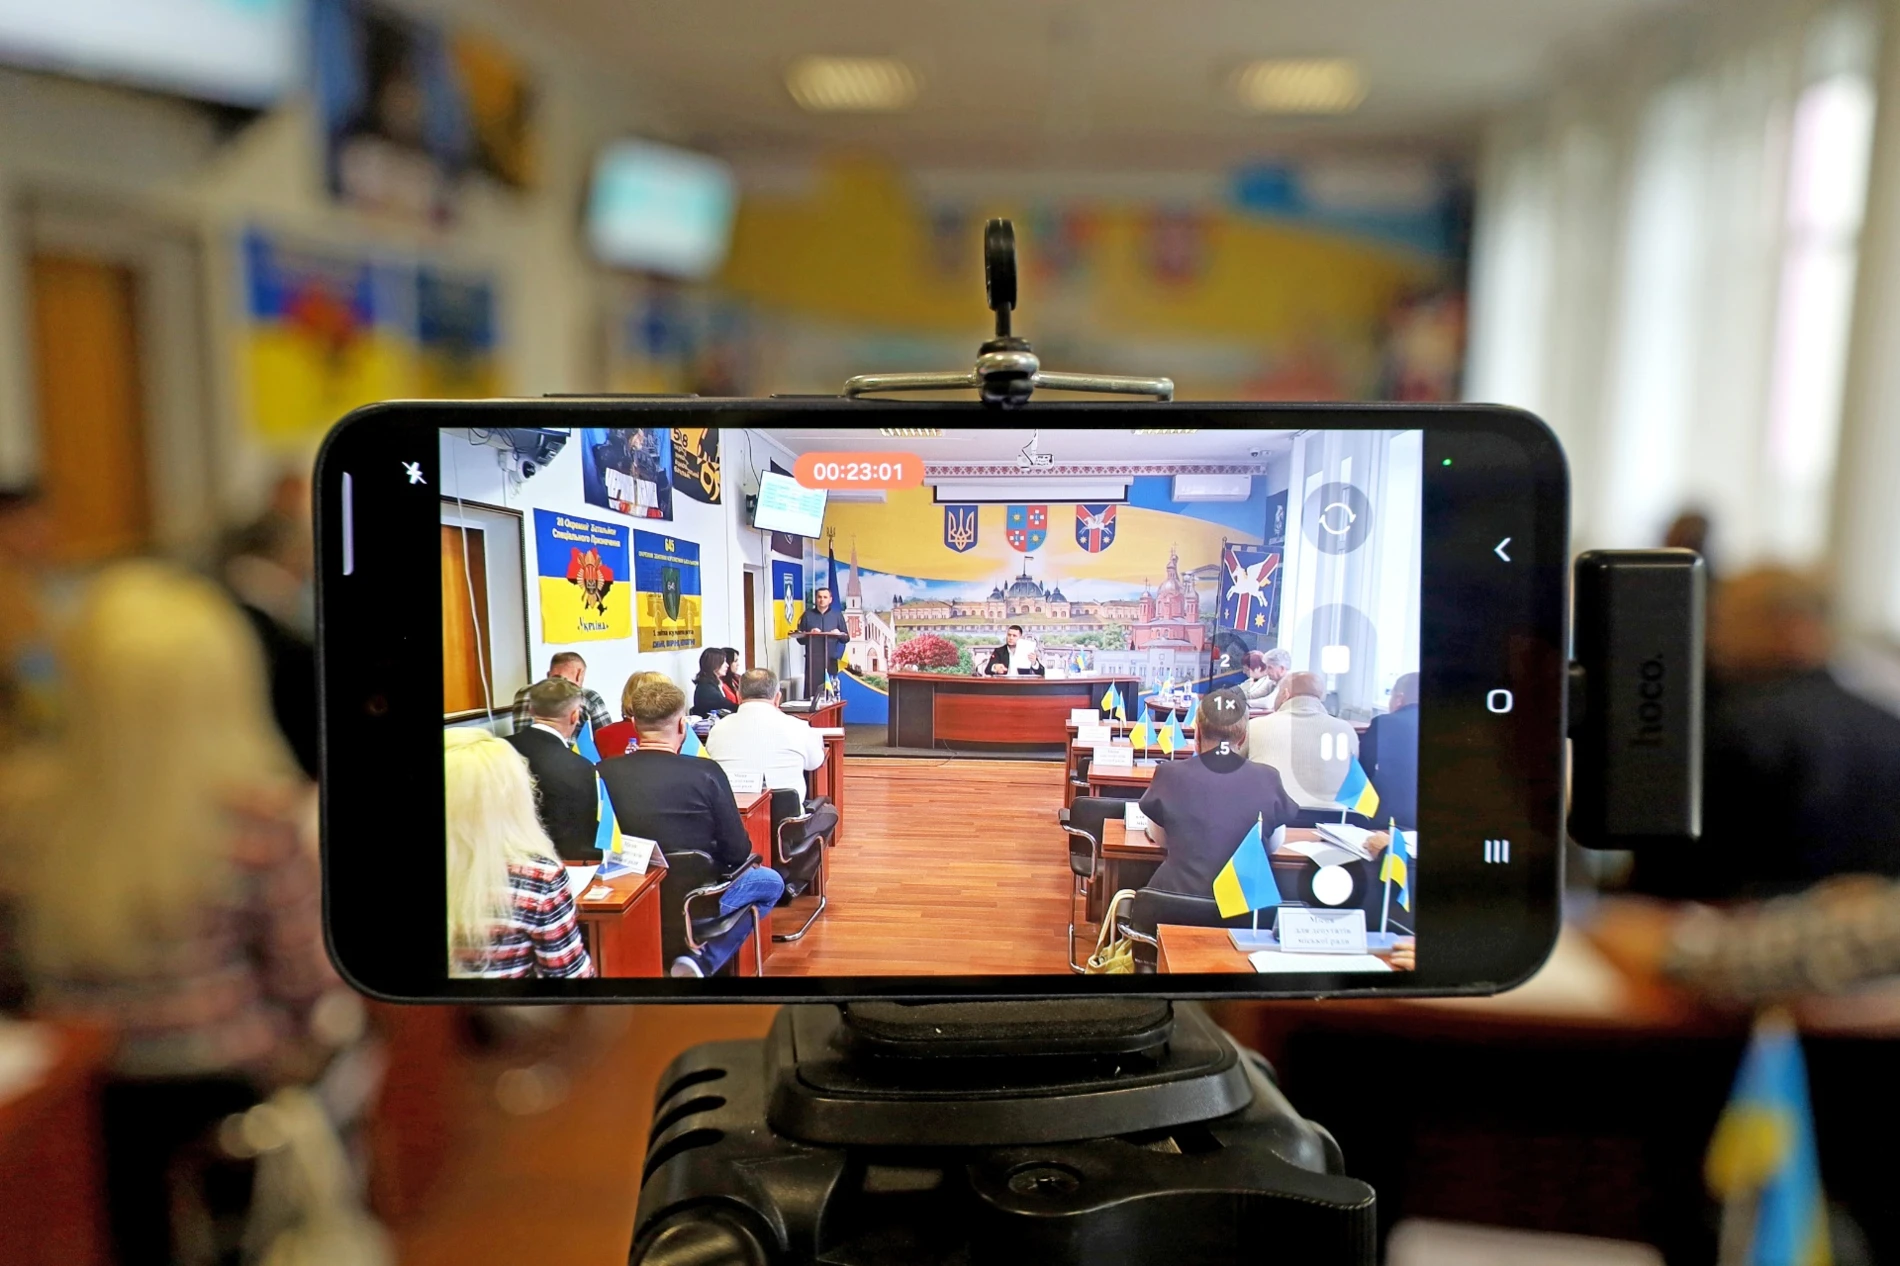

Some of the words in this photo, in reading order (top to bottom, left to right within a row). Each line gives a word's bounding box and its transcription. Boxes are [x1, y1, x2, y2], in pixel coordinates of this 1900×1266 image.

[813, 462, 903, 481] 00:23:01
[664, 538, 675, 553] 645
[1220, 654, 1230, 667] 2
[1215, 742, 1230, 755] .5
